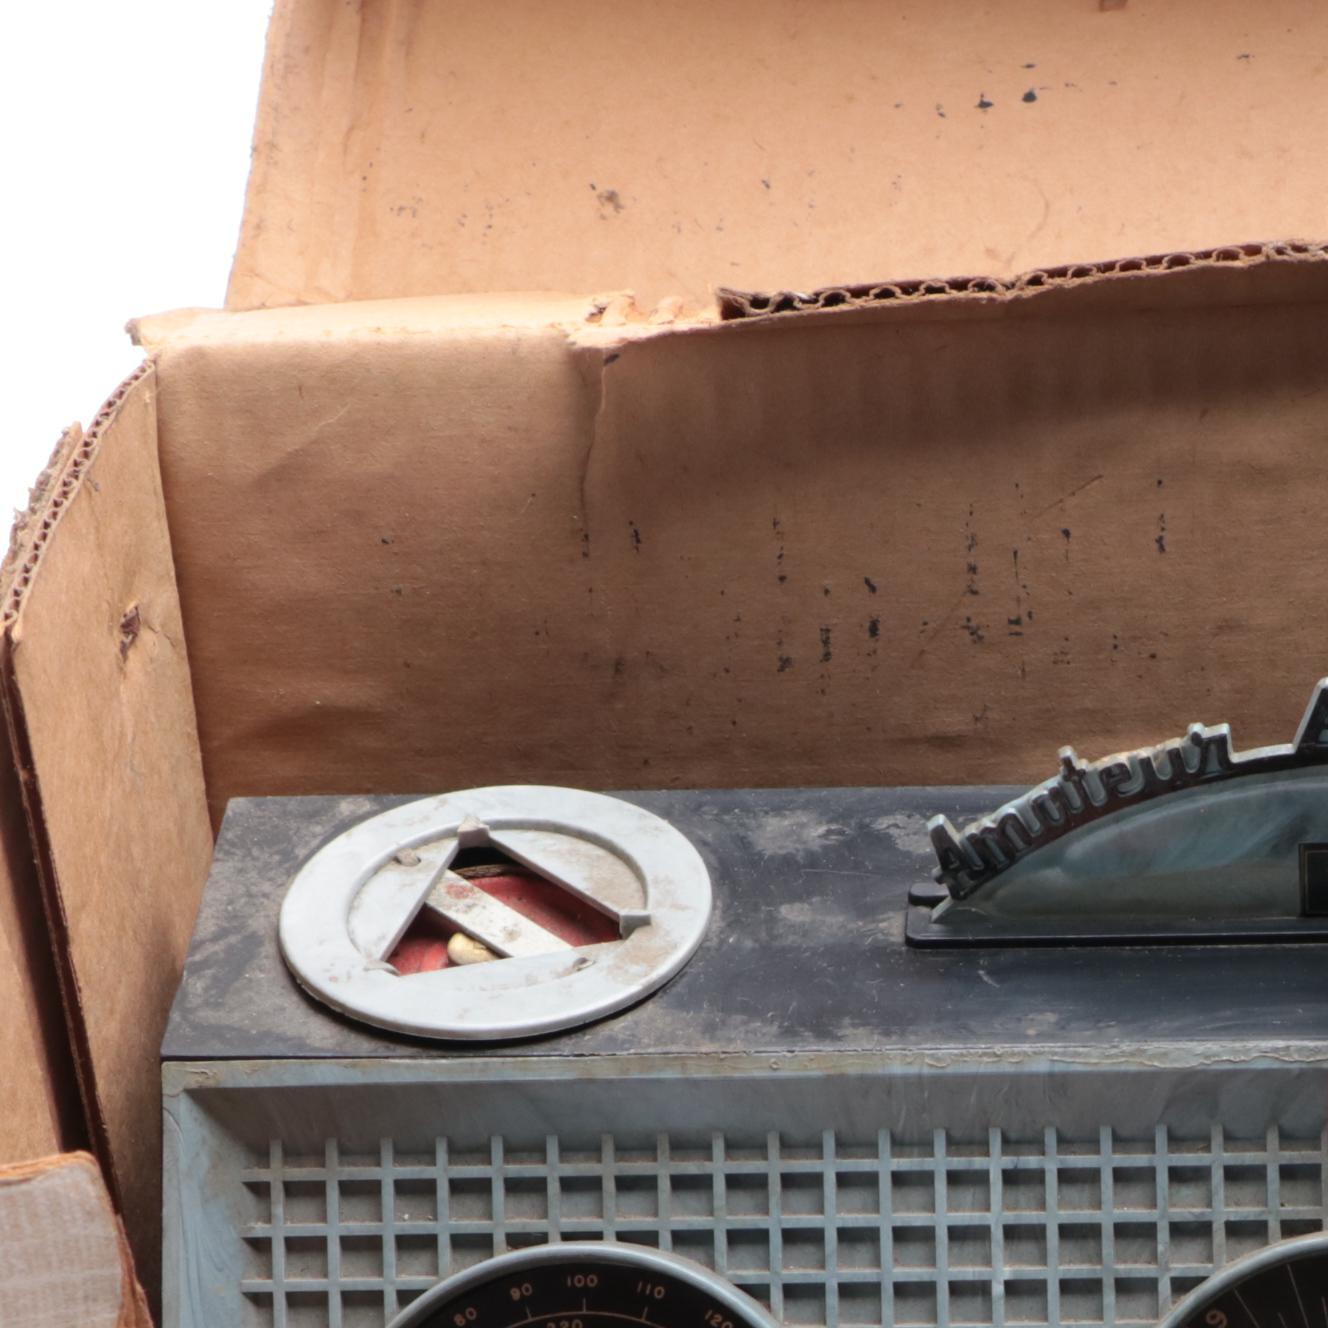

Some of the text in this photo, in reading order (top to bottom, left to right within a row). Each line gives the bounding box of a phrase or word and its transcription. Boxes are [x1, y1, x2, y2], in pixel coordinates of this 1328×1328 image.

[453, 1307, 477, 1327] 80
[510, 1282, 533, 1301] 90
[566, 1274, 599, 1290] 100
[636, 1281, 666, 1300] 110
